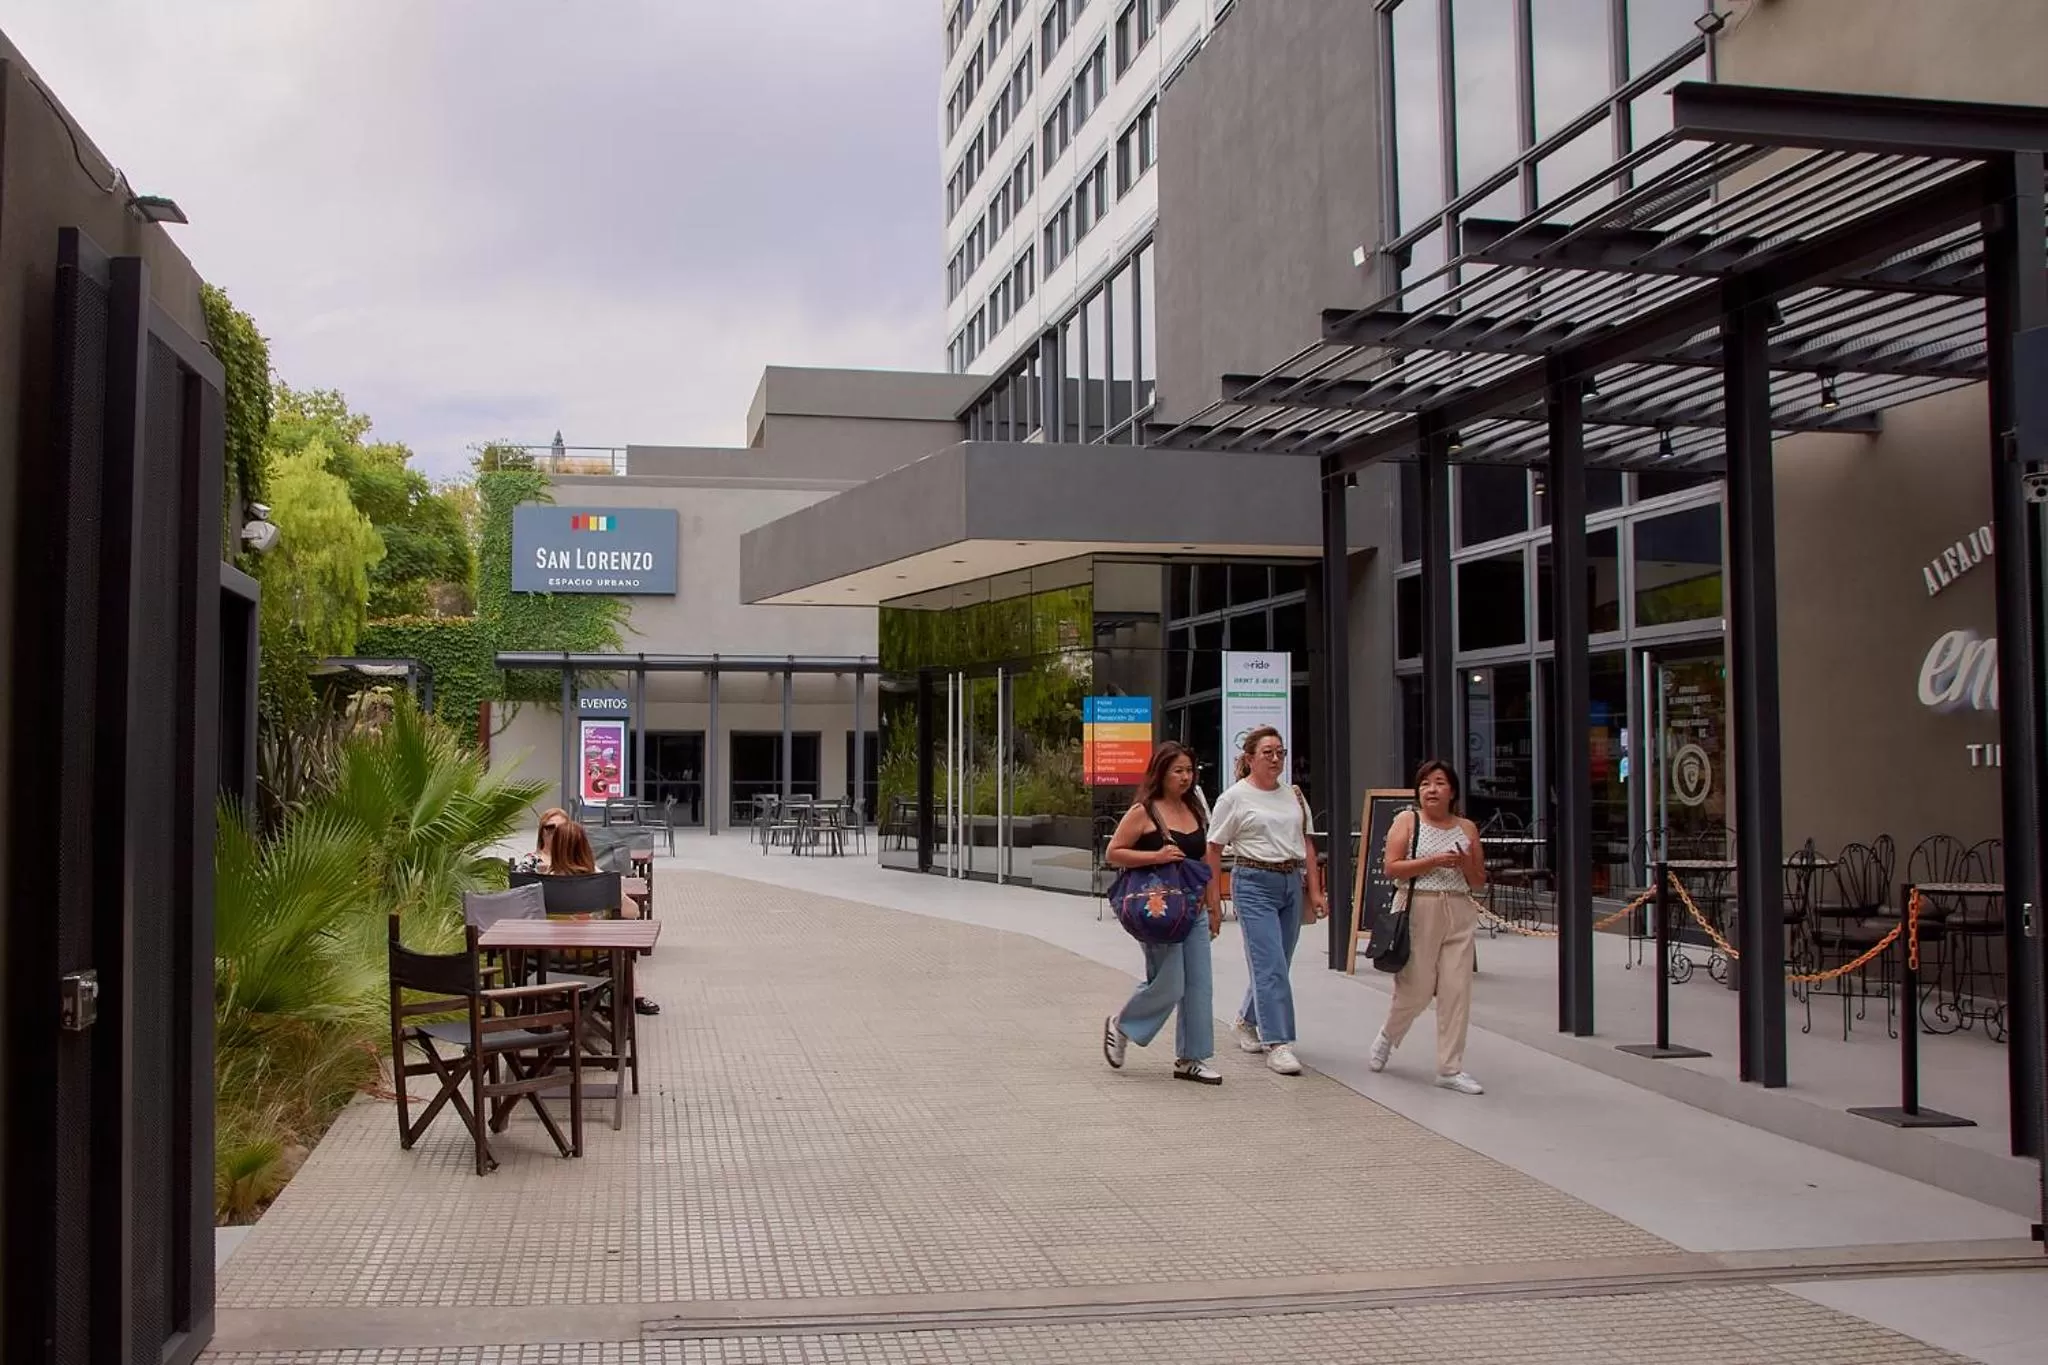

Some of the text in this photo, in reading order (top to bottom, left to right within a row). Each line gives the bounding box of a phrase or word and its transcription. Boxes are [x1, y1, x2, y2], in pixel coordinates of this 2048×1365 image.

[536, 547, 653, 571] SAN LORENZO
[1922, 521, 1995, 597] ALFAJO
[548, 578, 640, 587] ESPACIO URBANO
[581, 698, 628, 709] EVENTOS
[1966, 743, 2001, 767] TI
